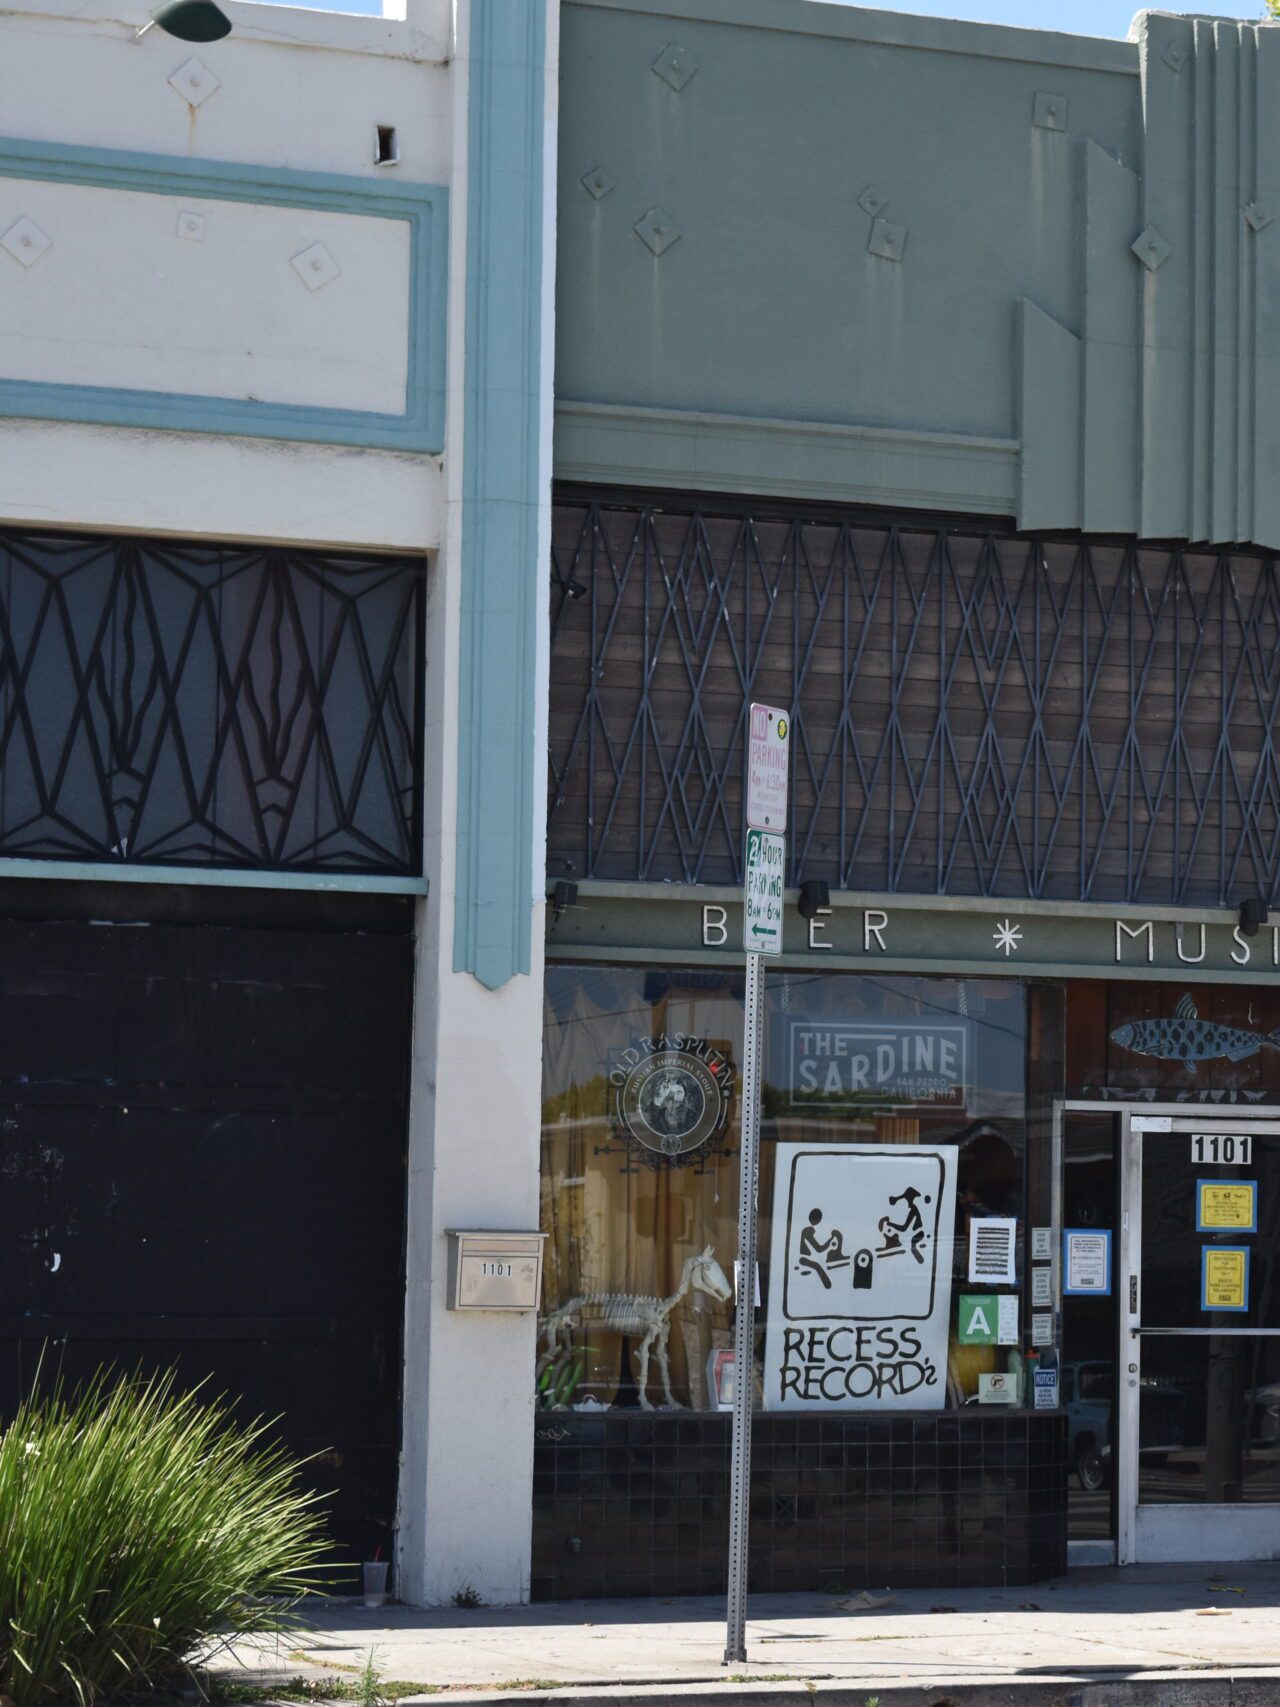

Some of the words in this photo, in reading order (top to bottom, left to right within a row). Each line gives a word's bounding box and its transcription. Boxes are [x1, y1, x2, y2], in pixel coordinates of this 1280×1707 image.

[752, 708, 767, 738] NO
[751, 743, 786, 770] PARKING
[762, 844, 783, 865] HOUR
[703, 905, 888, 951] BER
[800, 1032, 848, 1056] THE
[609, 1047, 640, 1086] OLD
[639, 1032, 735, 1088] RASPUTIN
[800, 1035, 957, 1096] SARDINE
[631, 1064, 656, 1094] RUSSIAN
[657, 1057, 694, 1073] IMPERIAL
[696, 1070, 713, 1095] STOUT
[897, 1077, 915, 1087] SAN
[1195, 1136, 1249, 1163] 1101
[482, 1263, 512, 1277] 1101
[966, 1306, 991, 1335] A
[783, 1326, 922, 1362] RECESS
[1034, 1371, 1056, 1386] NOTICE
